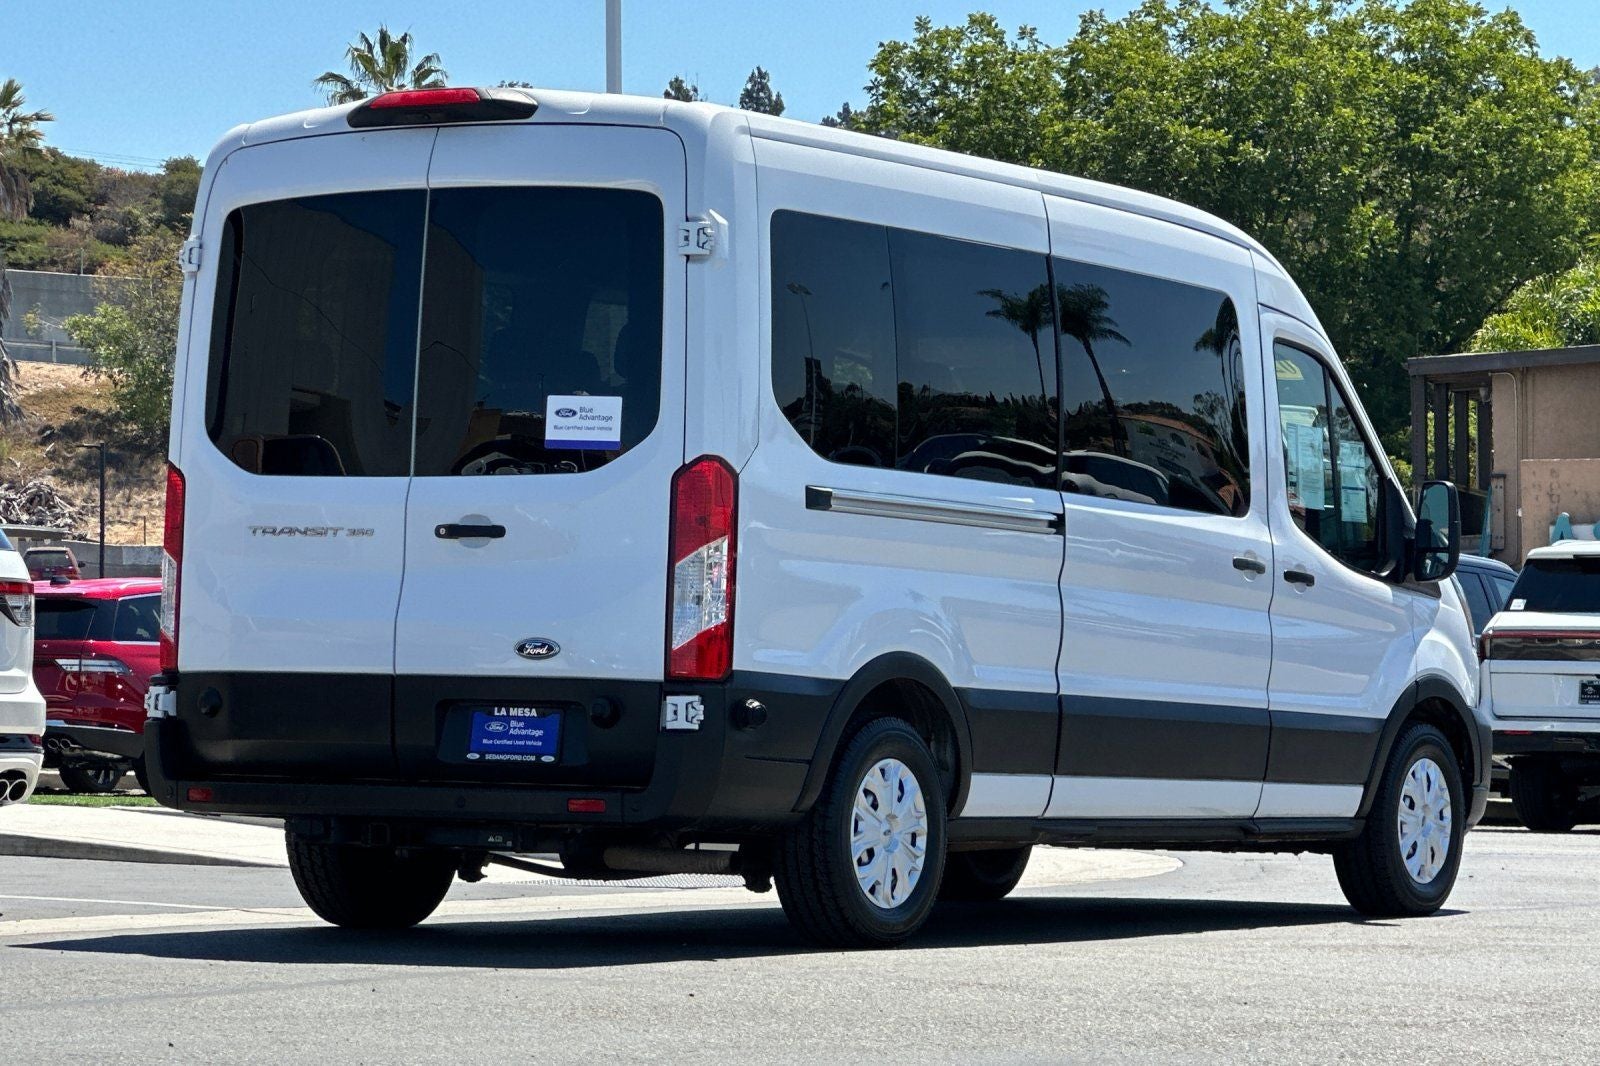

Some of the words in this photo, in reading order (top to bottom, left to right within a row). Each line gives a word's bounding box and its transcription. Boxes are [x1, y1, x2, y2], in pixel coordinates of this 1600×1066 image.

[578, 414, 613, 422] Advantage
[248, 525, 344, 537] TRANSIT
[346, 527, 375, 537] 350
[494, 706, 507, 716] LA
[509, 707, 537, 717] MESA
[510, 720, 525, 728] Blue
[508, 728, 544, 737] Advantage
